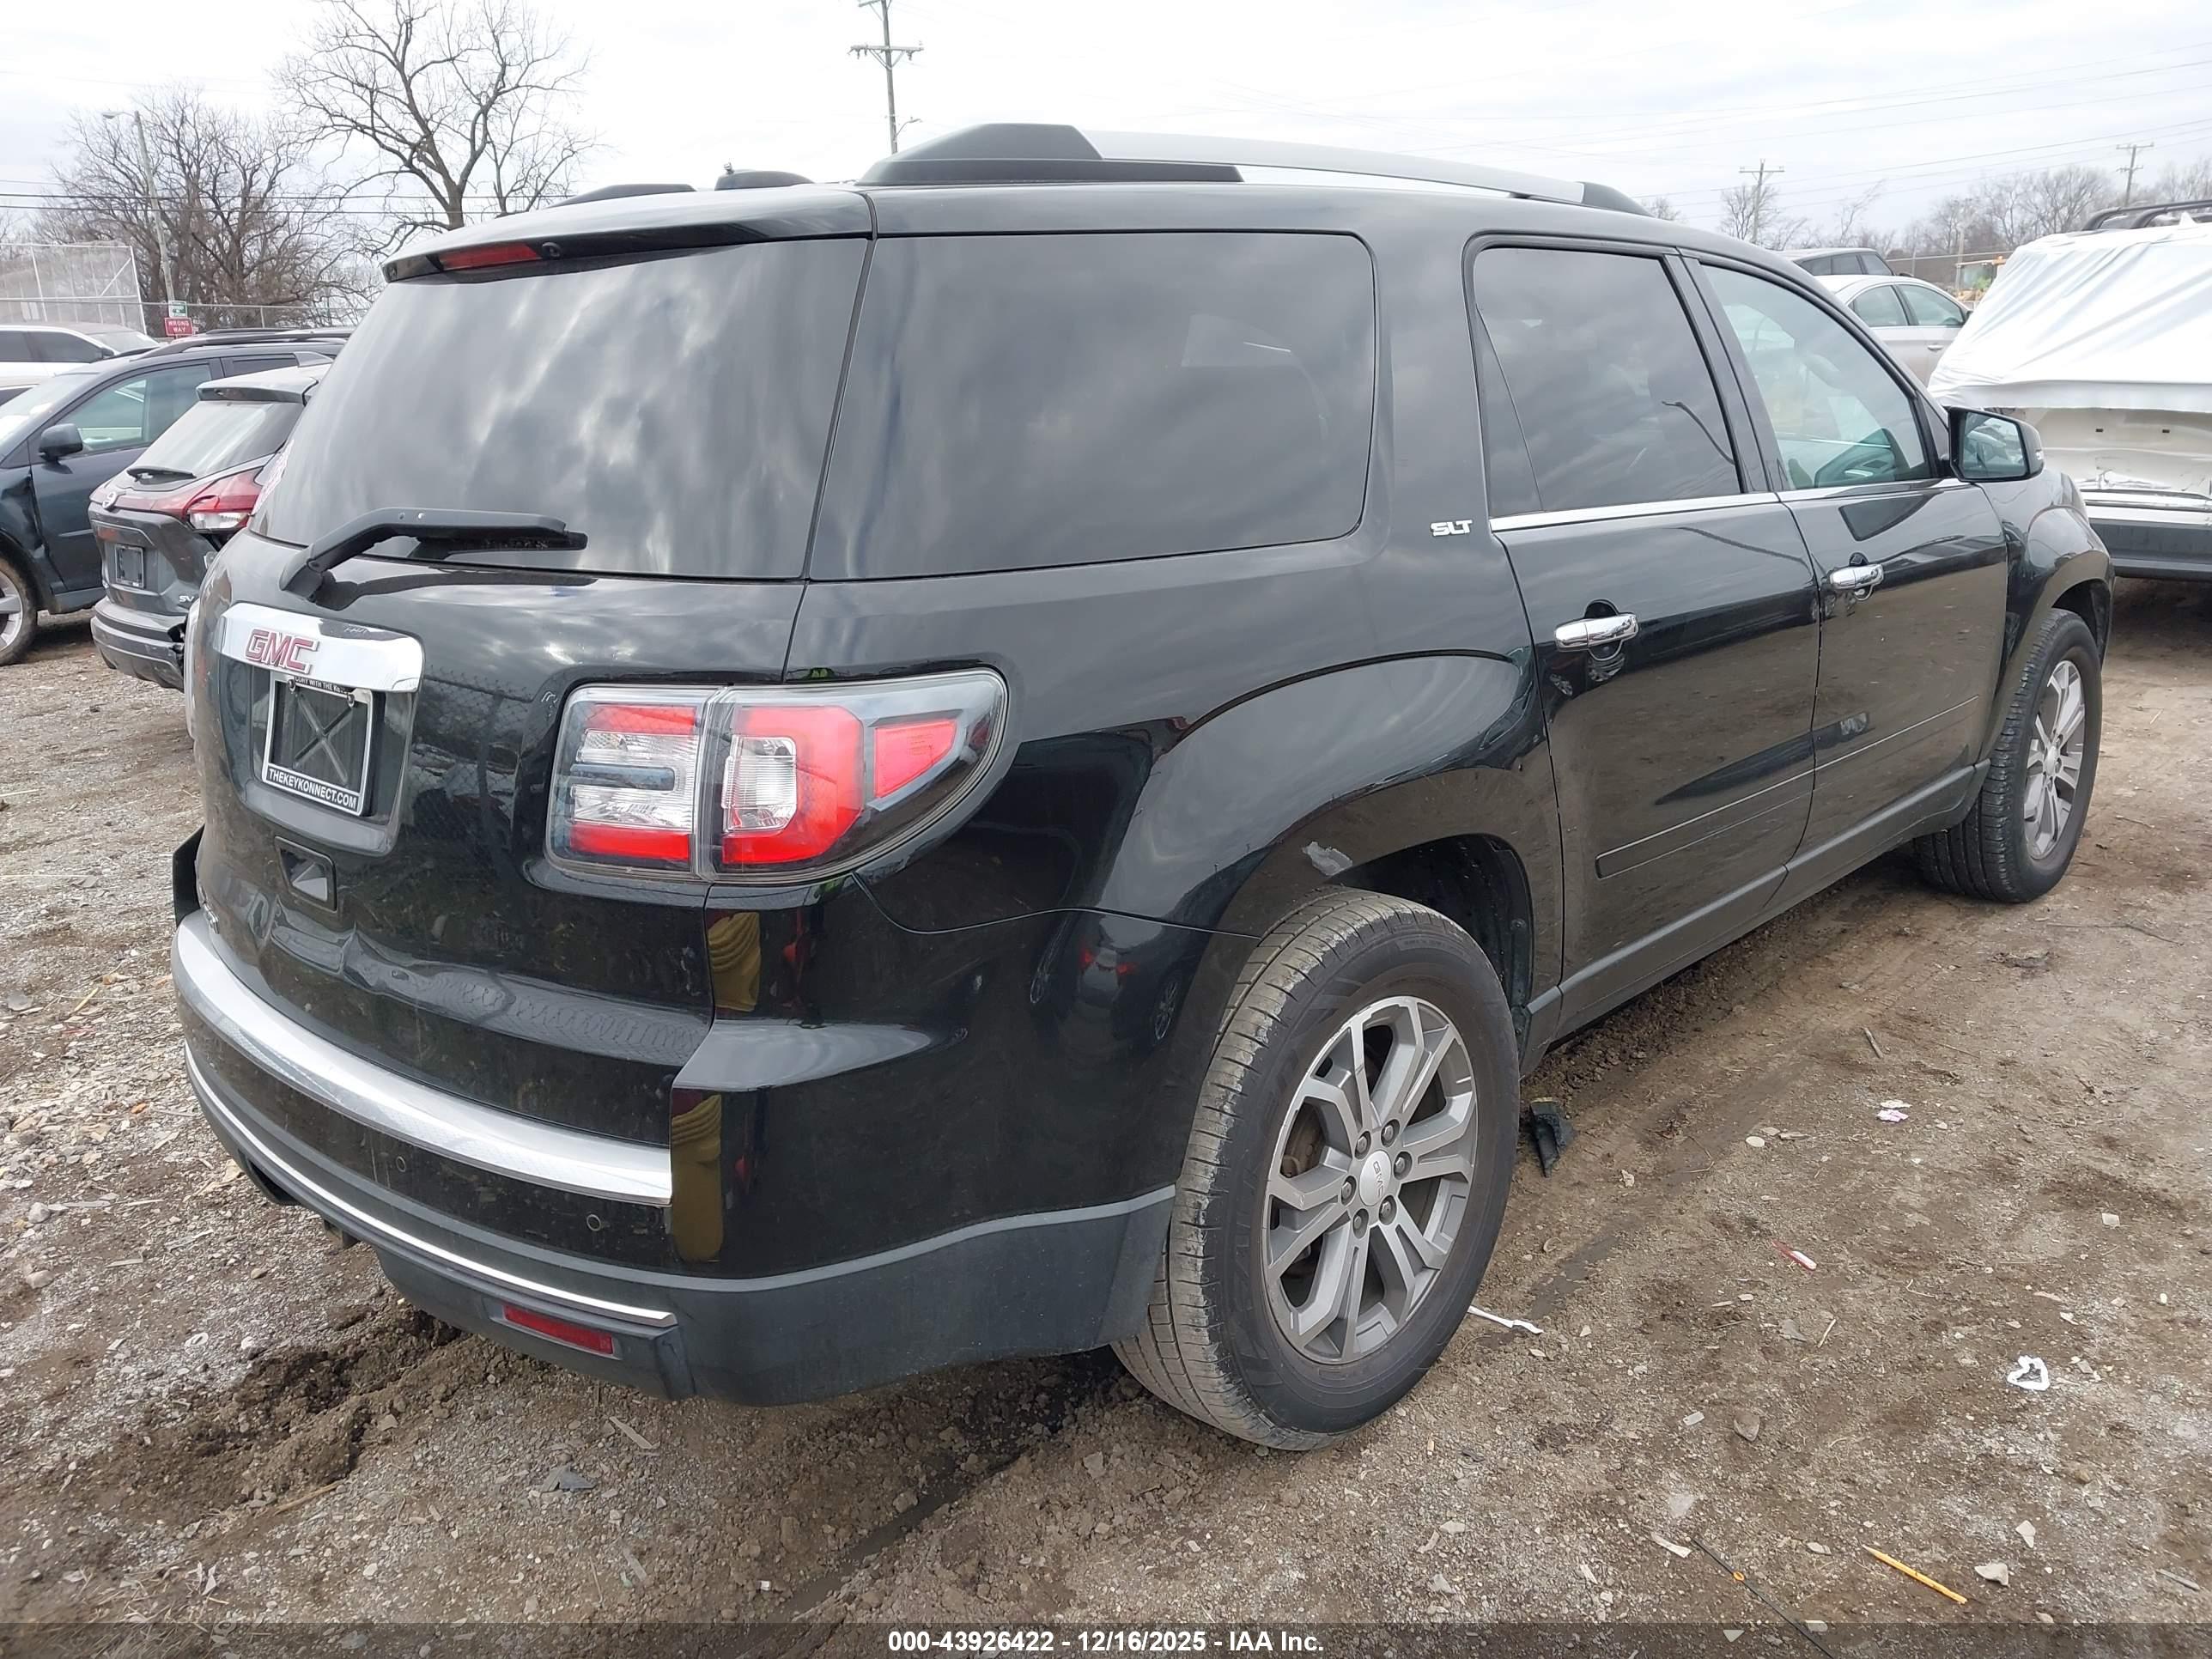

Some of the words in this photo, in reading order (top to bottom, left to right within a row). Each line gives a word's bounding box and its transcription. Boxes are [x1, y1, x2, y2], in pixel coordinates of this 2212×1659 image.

[1431, 520, 1473, 537] SLT
[245, 628, 318, 674] GMC
[269, 769, 357, 810] THEKEYKONNECT.COM
[1373, 1160, 1384, 1198] GMC
